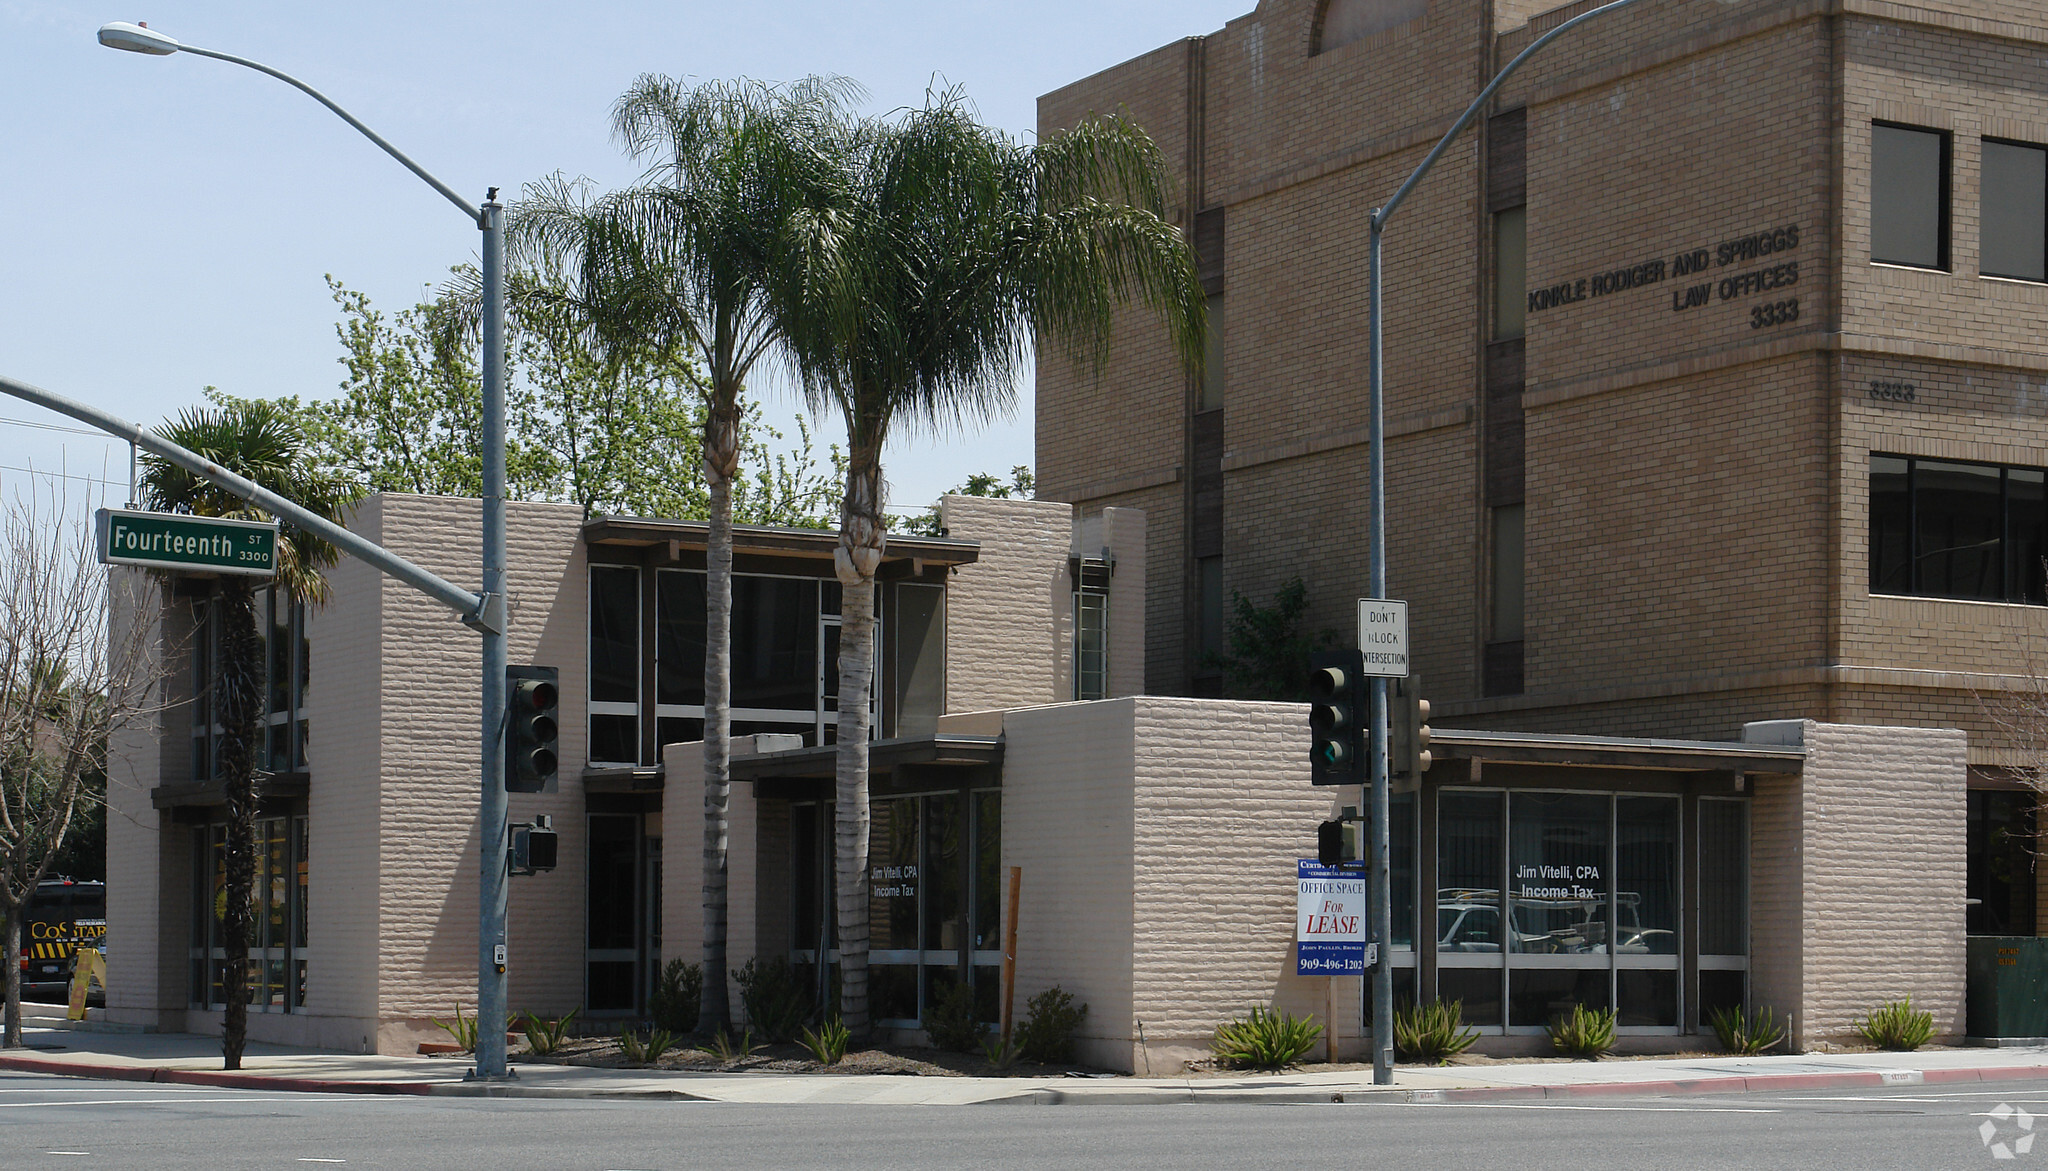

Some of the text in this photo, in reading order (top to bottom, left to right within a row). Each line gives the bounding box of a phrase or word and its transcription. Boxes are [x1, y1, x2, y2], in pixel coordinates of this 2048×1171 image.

[1528, 225, 1799, 312] KINKLE RODIGER AND SPRIGGS
[1672, 261, 1799, 311] LAW OFFICES
[1750, 299, 1799, 329] 3333
[1870, 381, 1915, 401] 3333
[115, 525, 262, 557] Fourteenth ST
[239, 551, 269, 562] 3300
[1370, 612, 1396, 623] DON'T
[1363, 652, 1405, 664] NTERSECTION
[871, 867, 882, 879] Jim
[904, 865, 917, 878] CPA
[1516, 865, 1599, 881] Jim Vitelli, CPA
[874, 884, 914, 897] Income Tax
[1522, 884, 1594, 898] Income Tax
[1305, 915, 1359, 934] LEASE
[1300, 958, 1362, 969] 909-496-1202
